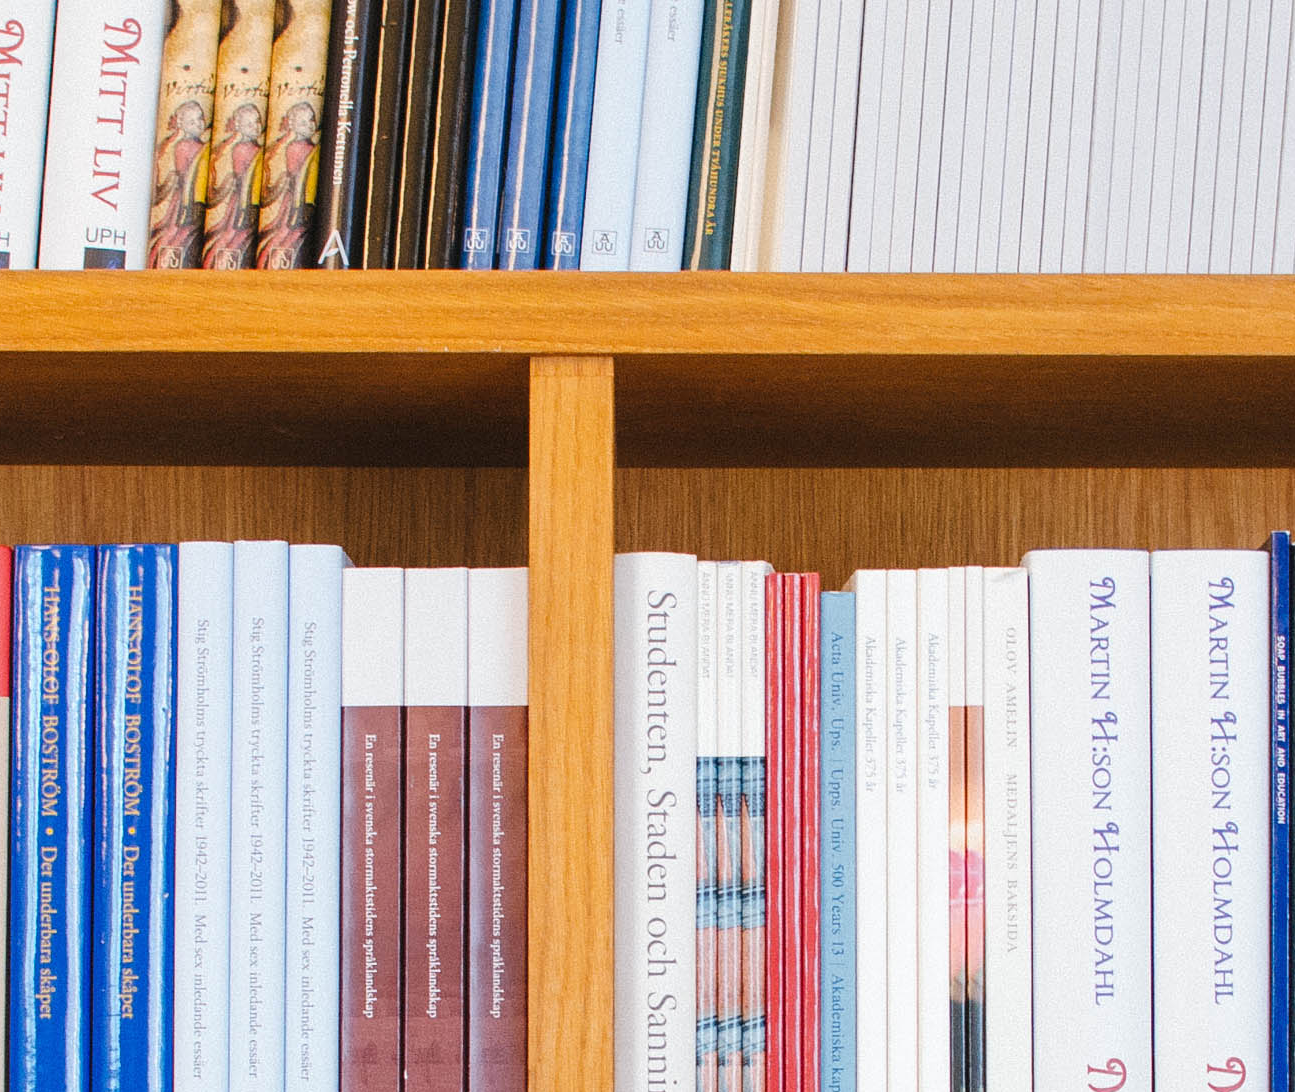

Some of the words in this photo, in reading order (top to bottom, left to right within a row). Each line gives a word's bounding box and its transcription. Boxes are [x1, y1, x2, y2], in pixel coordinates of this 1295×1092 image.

[344, 21, 359, 45] och
[96, 18, 143, 134] MITT
[337, 49, 357, 117] Petronella
[333, 120, 351, 185] Kettunen
[712, 109, 723, 147] UNDER
[90, 146, 122, 212] LIV
[706, 150, 722, 217] TVÅHUNDRA
[705, 219, 714, 235] ÅR
[125, 585, 142, 704] HANS-OLOF
[1277, 635, 1285, 660] SOAP
[640, 591, 678, 774] Studenten,
[1277, 666, 1285, 704] BUBBLES
[427, 734, 440, 749] En
[1277, 710, 1285, 719] IN
[1277, 725, 1285, 742] ART
[123, 714, 142, 816] BOSTRÖM
[427, 752, 440, 792] resenär
[1277, 747, 1285, 767] AND
[427, 802, 439, 844] svenska
[1277, 773, 1286, 824] EDUCATION
[123, 845, 139, 878] Det
[646, 789, 678, 900] Staden
[427, 848, 440, 937] stormaktstidens
[122, 882, 139, 963] underbara
[646, 917, 677, 977] och
[119, 968, 138, 1019] skåpet
[425, 939, 441, 1018] språklandskap
[831, 973, 844, 1062] Akademiska
